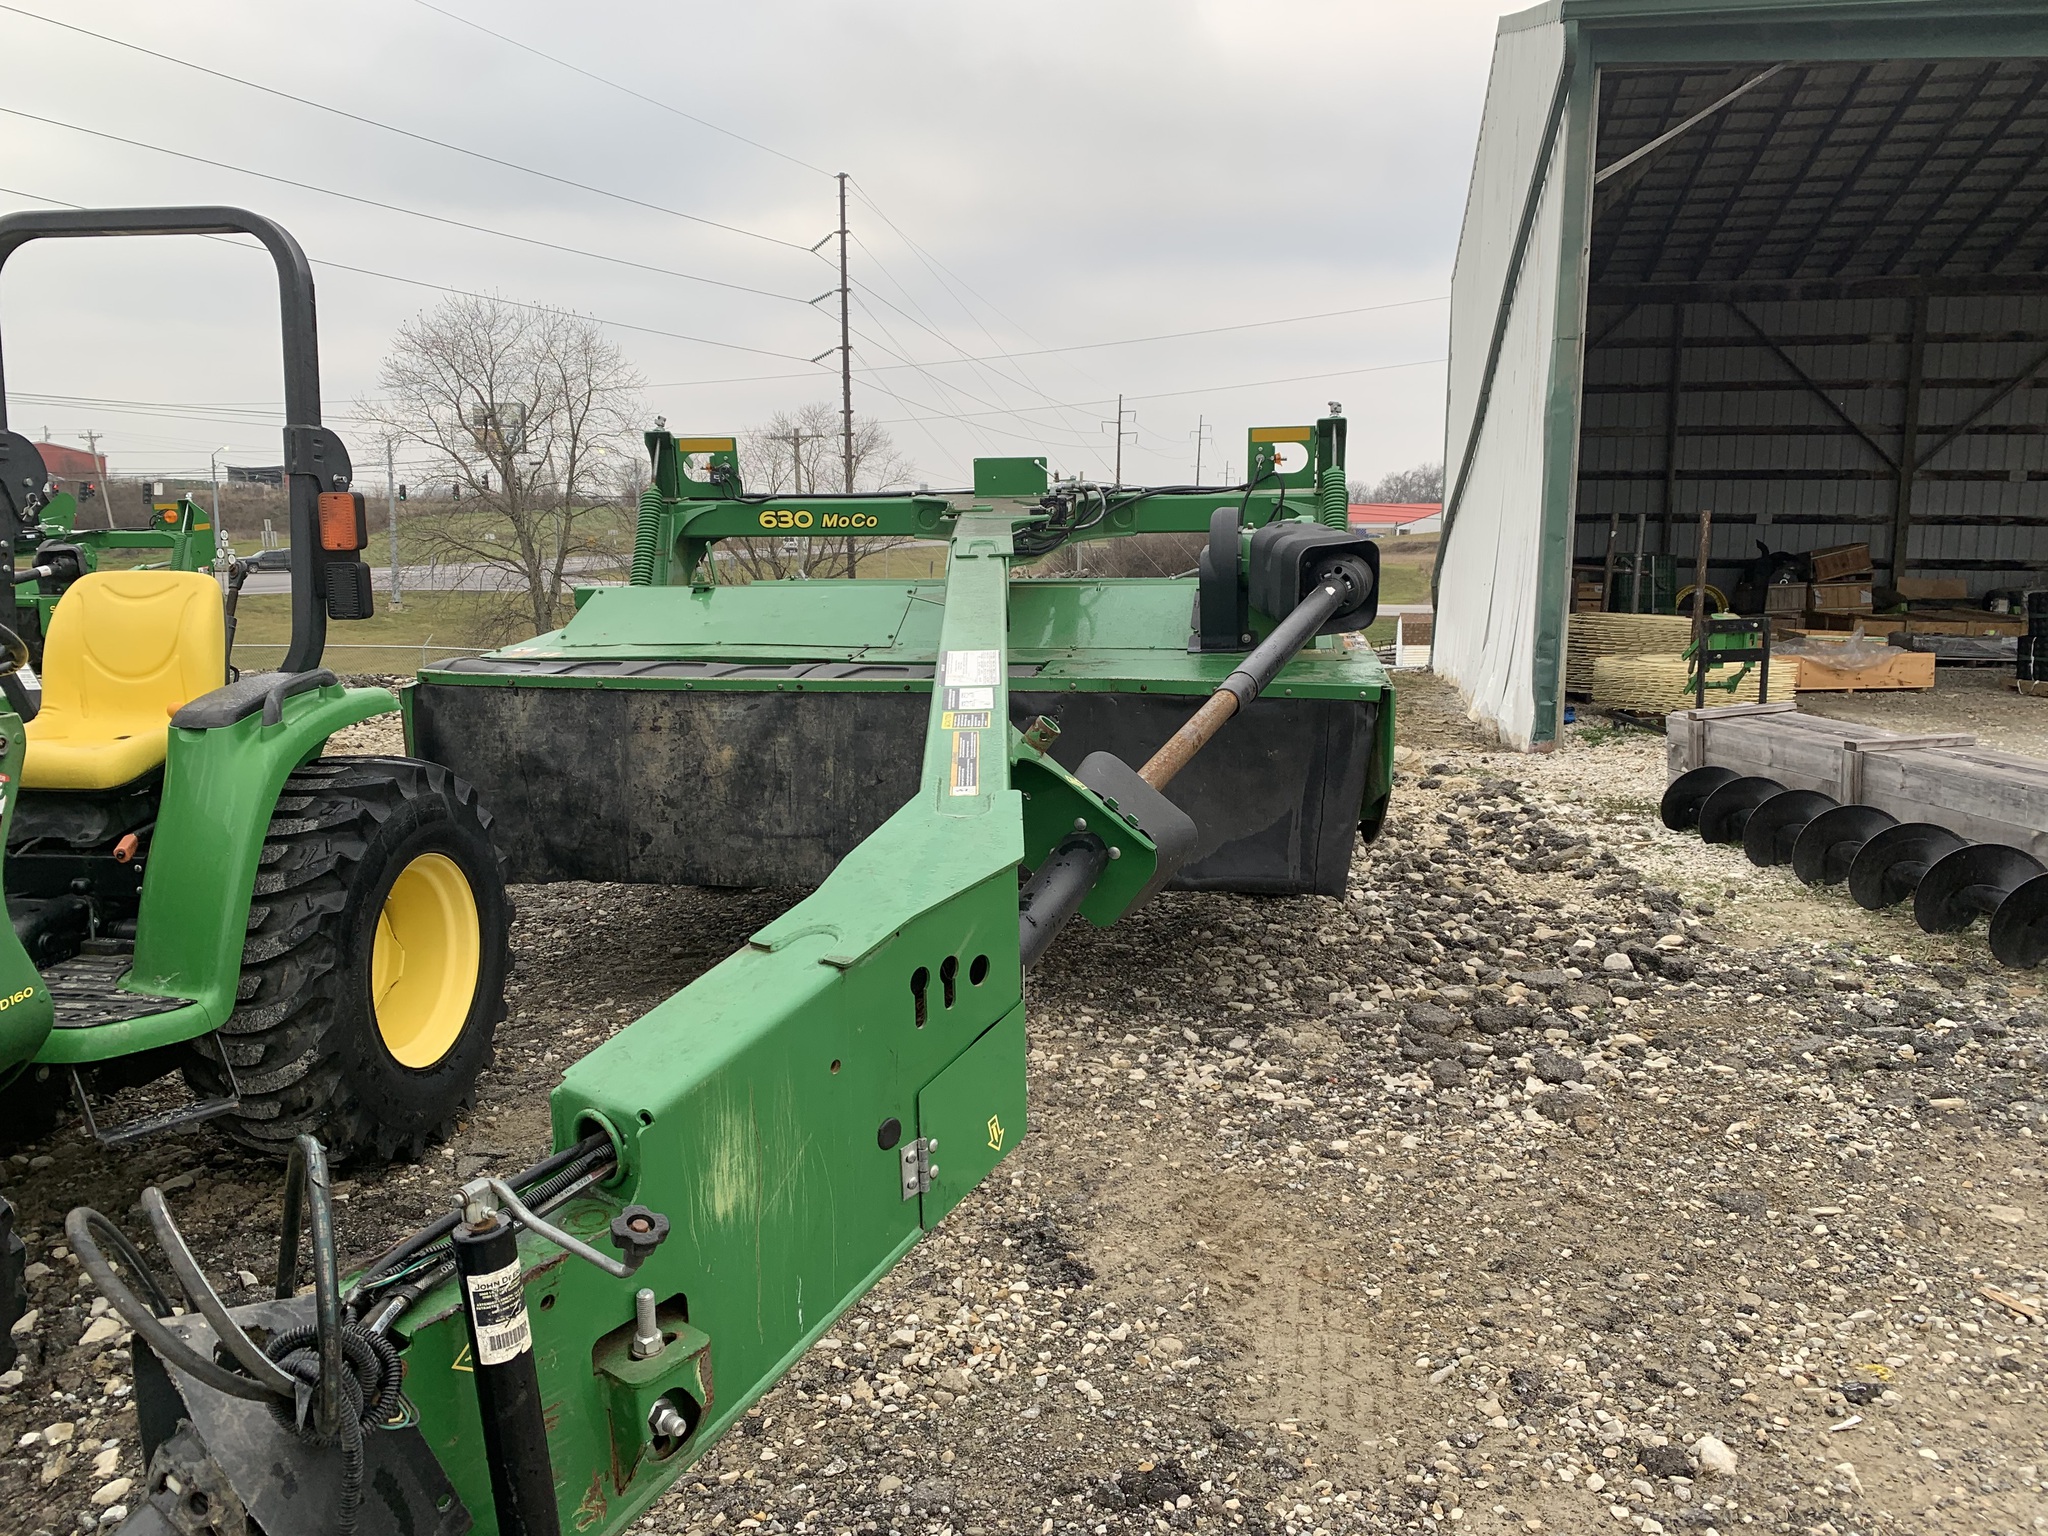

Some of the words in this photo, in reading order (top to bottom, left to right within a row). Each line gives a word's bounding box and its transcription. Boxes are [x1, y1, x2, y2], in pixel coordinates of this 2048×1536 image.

[759, 510, 814, 529] 630
[820, 512, 879, 529] MoCo
[474, 1280, 500, 1291] JOHN
